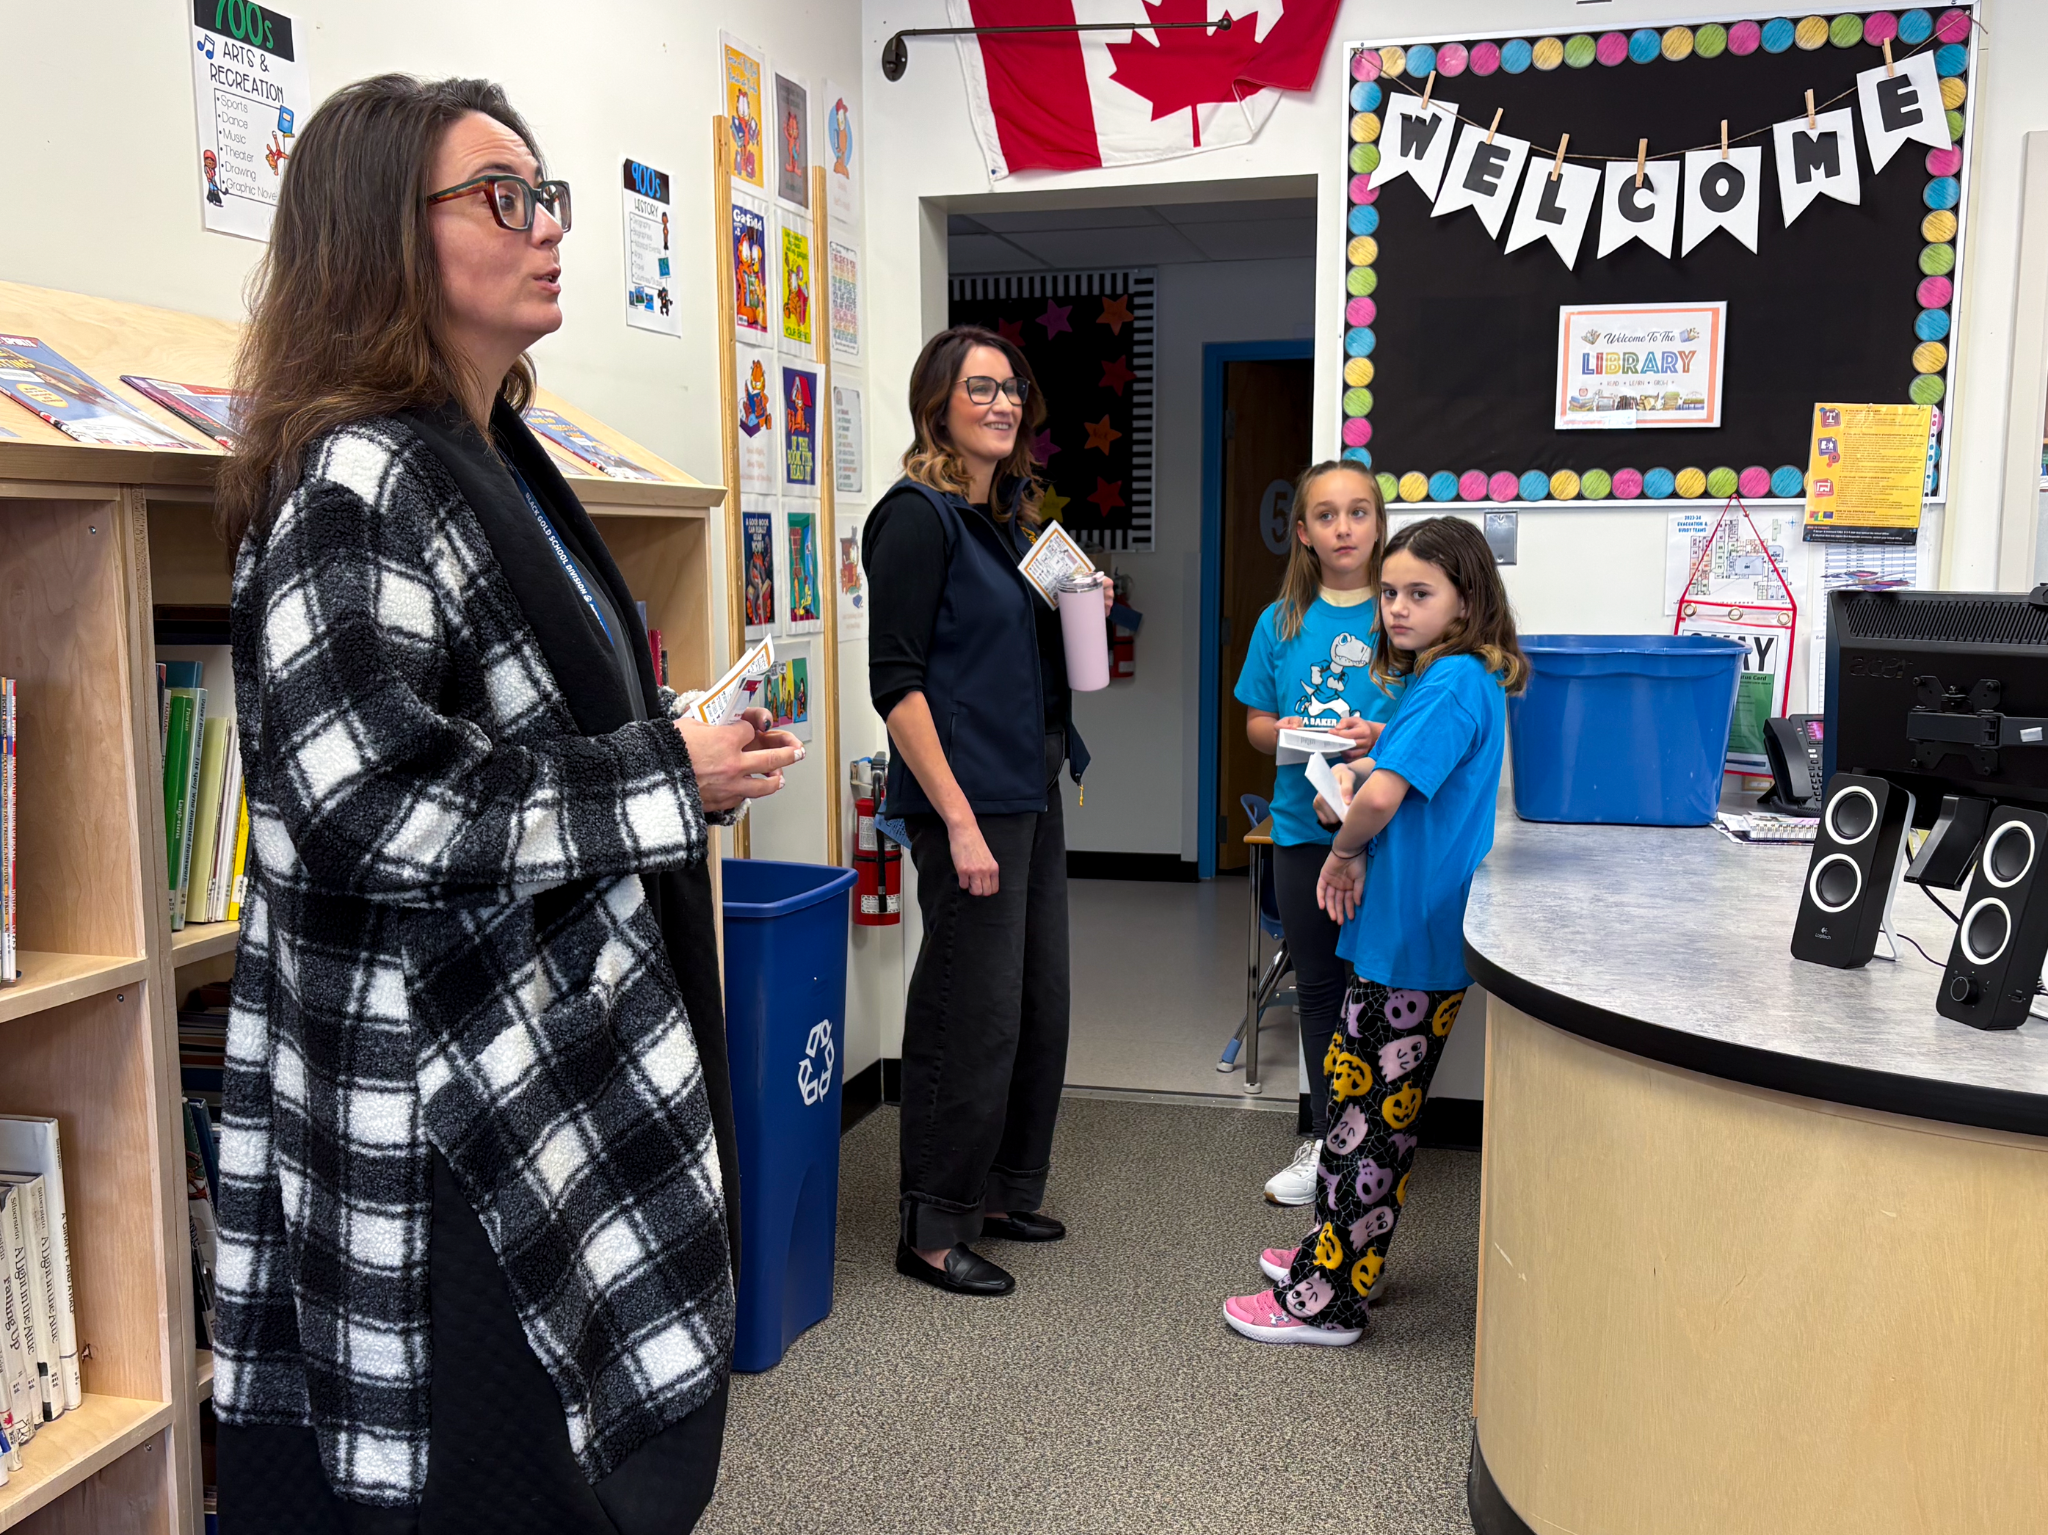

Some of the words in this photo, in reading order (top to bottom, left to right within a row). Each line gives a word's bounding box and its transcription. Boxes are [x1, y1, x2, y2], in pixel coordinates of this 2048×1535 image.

[222, 41, 255, 68] ARTS
[259, 53, 270, 73] &
[209, 62, 285, 104] RECREATION
[220, 94, 249, 114] Sports
[221, 111, 249, 129] Dance
[222, 128, 247, 145] Music
[224, 144, 254, 163] Theater
[1400, 72, 1924, 226] WELCOME
[225, 161, 257, 182] Drawing
[631, 161, 661, 199] 900s
[226, 178, 257, 197] Graphic
[634, 197, 659, 217] HISTORY
[1603, 332, 1646, 344] Welcome
[1647, 331, 1660, 343] To
[1659, 330, 1676, 342] The
[1581, 349, 1697, 375] LIBRARY
[525, 492, 540, 516] BLACK
[537, 515, 552, 536] GOLD
[548, 535, 570, 565] SCHOOL
[565, 564, 588, 595] DIVISION
[1849, 657, 1913, 678] acer
[1310, 717, 1337, 726] BAKER
[1814, 932, 1832, 940] Logitech
[10, 1196, 20, 1240] Silverstein
[37, 1186, 46, 1230] Silverstein
[15, 1246, 24, 1259] A
[41, 1236, 49, 1247] A
[40, 1247, 52, 1279] Light
[65, 1264, 73, 1283] AND
[14, 1259, 28, 1291] Light
[3, 1274, 16, 1332] Falling
[10, 1326, 21, 1351] Up
[22, 1303, 32, 1325] the
[48, 1292, 56, 1314] the
[48, 1314, 58, 1344] Attic
[24, 1325, 35, 1356] Attic
